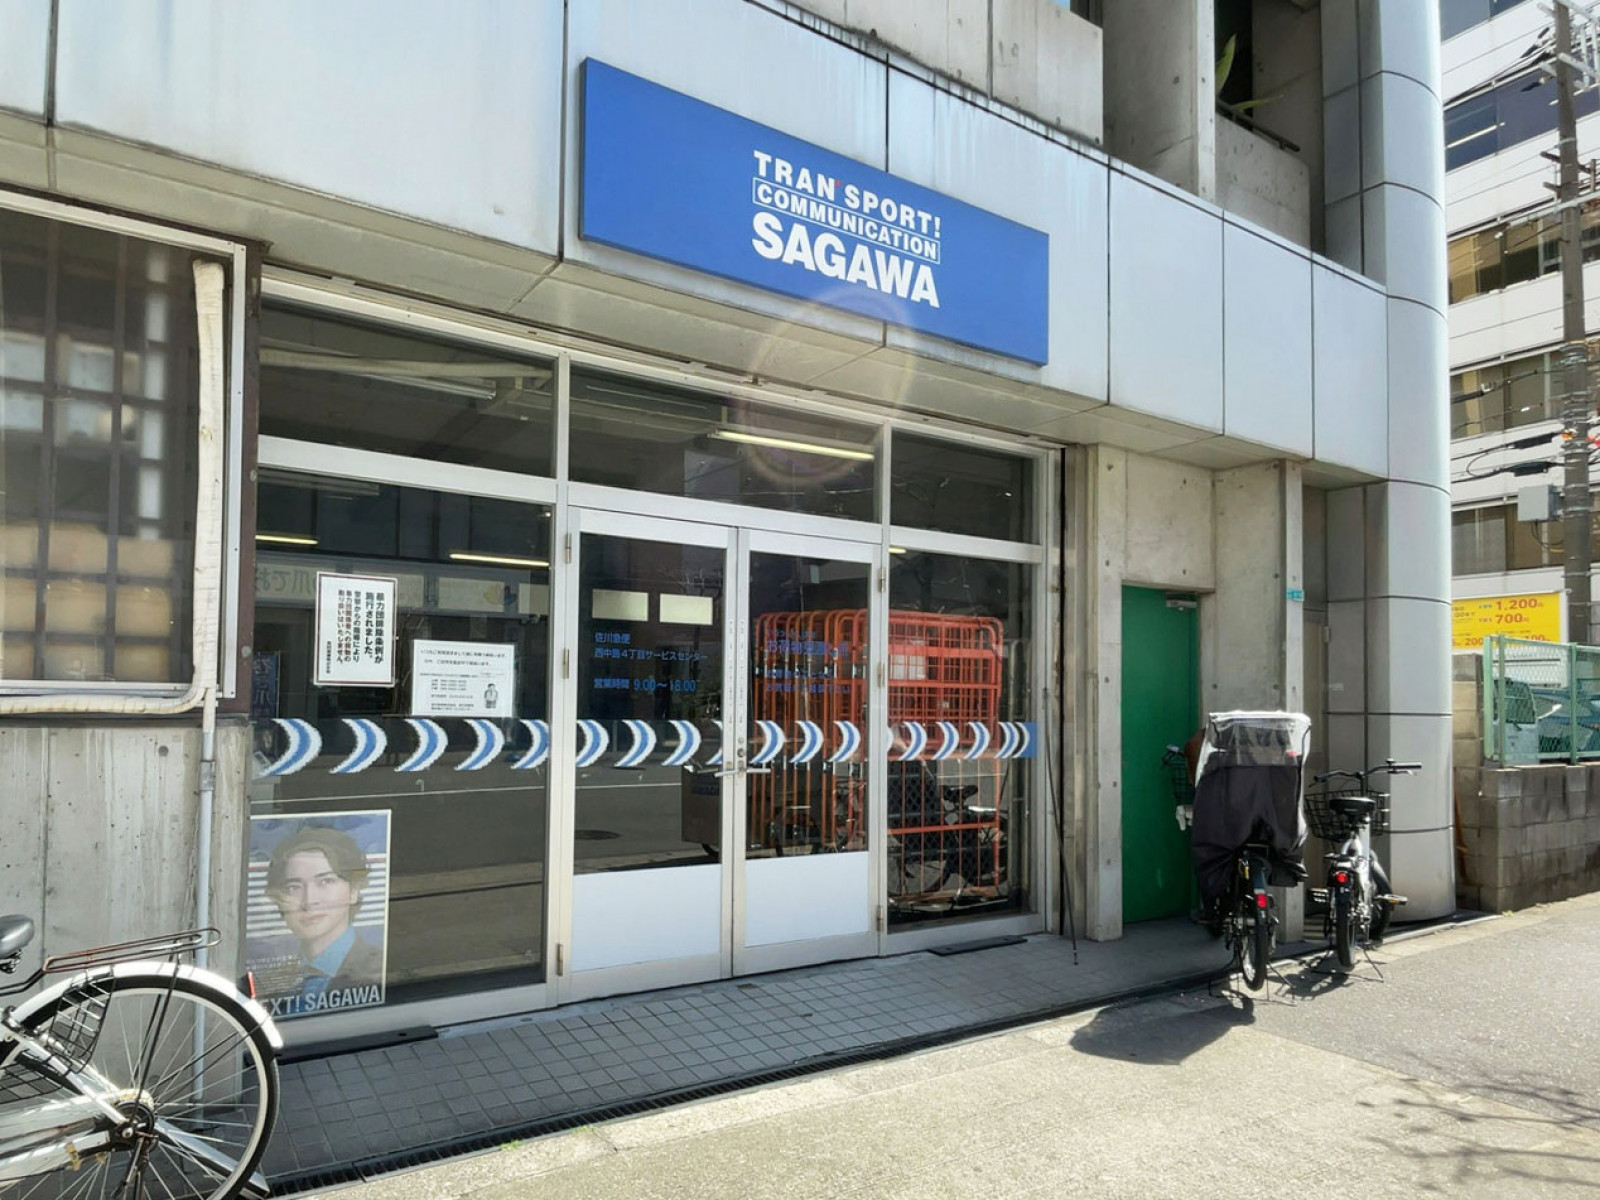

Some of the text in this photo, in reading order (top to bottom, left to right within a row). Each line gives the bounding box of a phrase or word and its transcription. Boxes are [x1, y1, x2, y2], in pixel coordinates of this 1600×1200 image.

[757, 184, 937, 260] COMMUNICATION
[752, 212, 940, 309] SAGAWA
[304, 984, 381, 1012] SAGAWA
